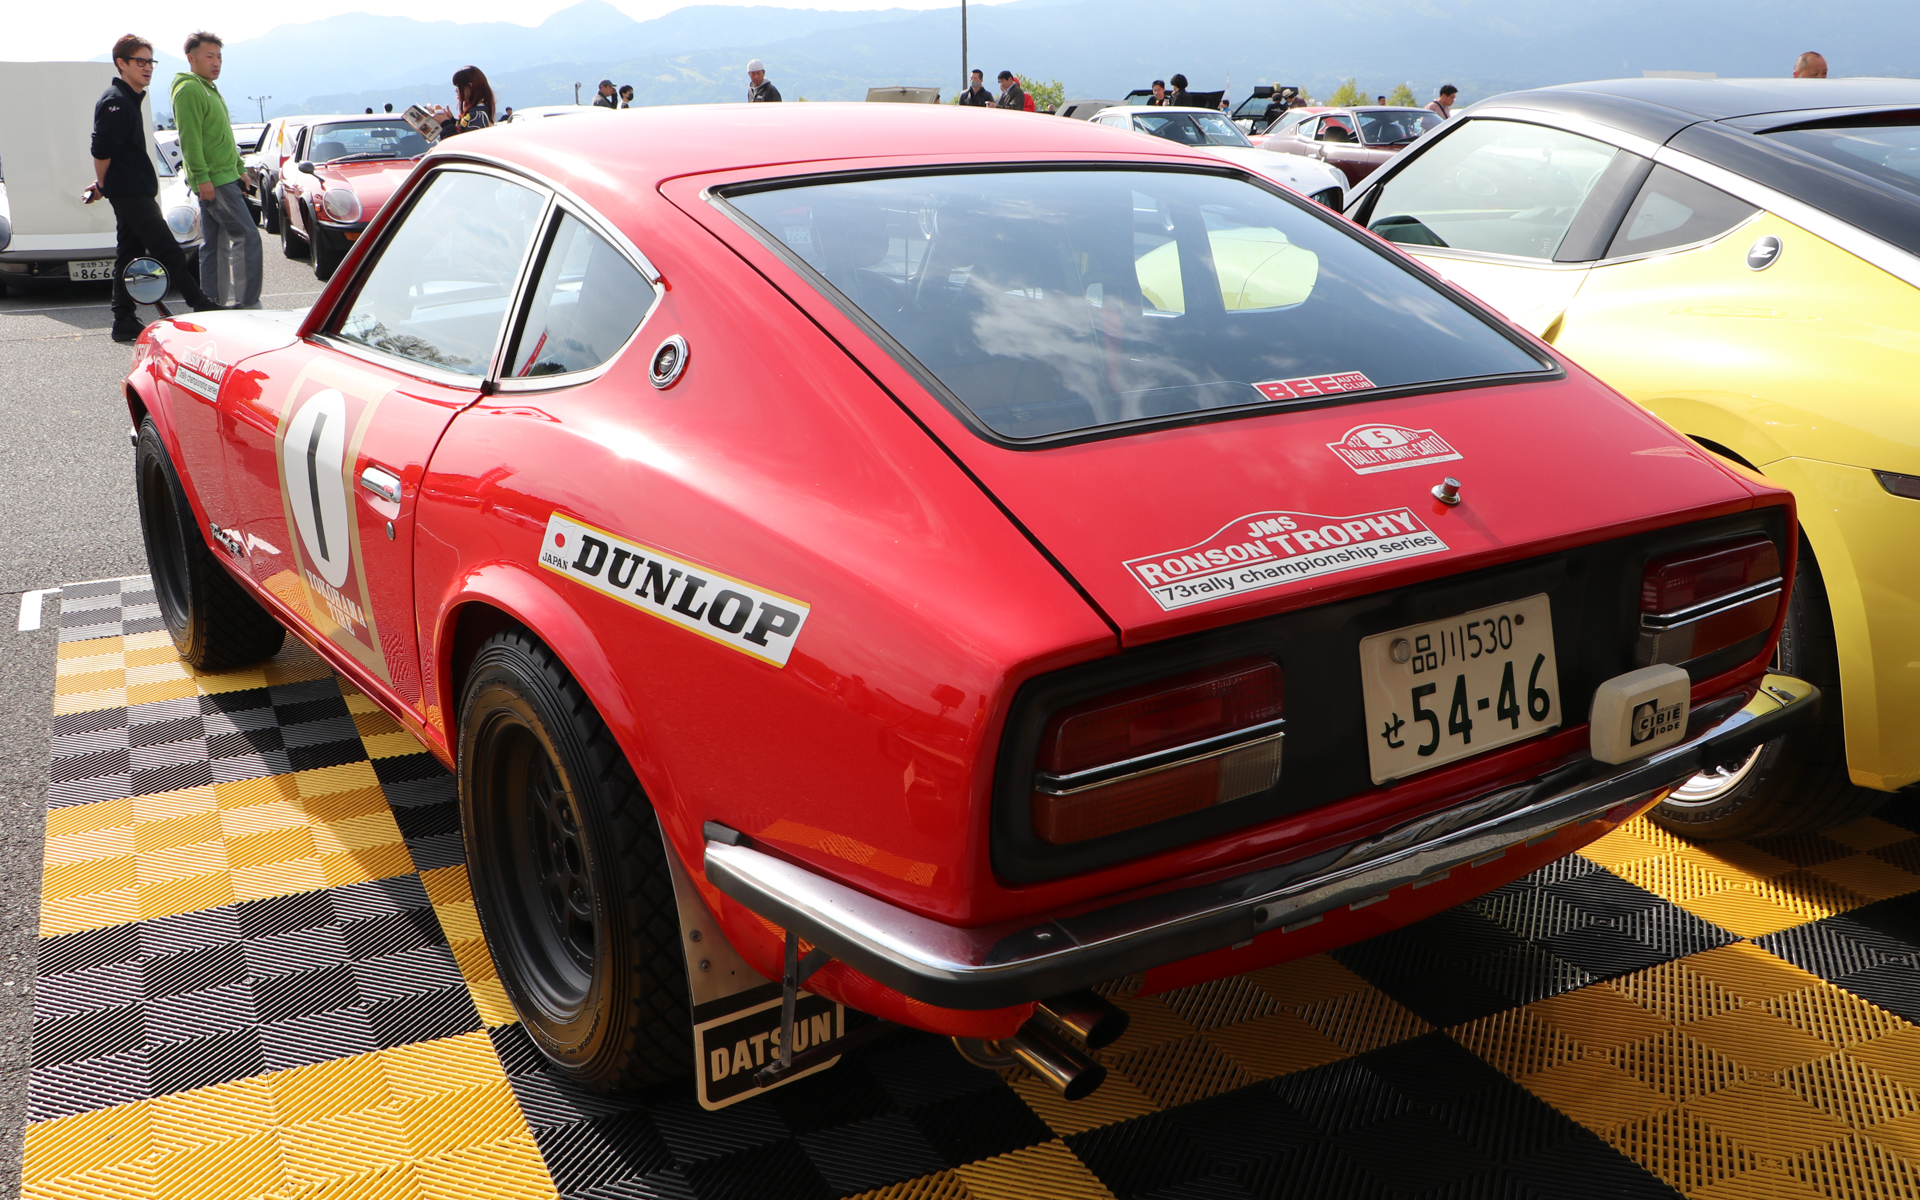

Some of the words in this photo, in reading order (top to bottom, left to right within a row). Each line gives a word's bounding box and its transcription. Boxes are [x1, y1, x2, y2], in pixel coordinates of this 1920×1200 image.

[199, 357, 227, 382] TROPHY
[1336, 374, 1364, 384] AUTO
[1343, 381, 1372, 390] CLUB
[1255, 377, 1344, 401] BEE
[1338, 448, 1387, 467] RALLYE
[1378, 435, 1450, 461] MONTE-CARLO
[1346, 434, 1367, 448] 1972
[1371, 430, 1393, 445] 5
[1397, 429, 1421, 441] 1972
[307, 411, 330, 563] 1
[1247, 515, 1299, 539] JMS
[542, 552, 569, 571] JAPAN
[1136, 540, 1272, 586] RONSON
[1266, 511, 1419, 557] TROPHY
[1239, 547, 1379, 584] championship
[1374, 532, 1438, 555] series
[305, 568, 368, 629] YOKOHAMA
[571, 534, 801, 648] DUNLOP
[326, 599, 356, 637] TIRE
[1380, 712, 1406, 749] せ
[1411, 652, 1551, 757] 54-46
[1640, 707, 1681, 730] CIBIE
[1655, 721, 1680, 736] IODE
[1690, 790, 1748, 825] SPORT
[710, 1011, 831, 1082] DATSUN
